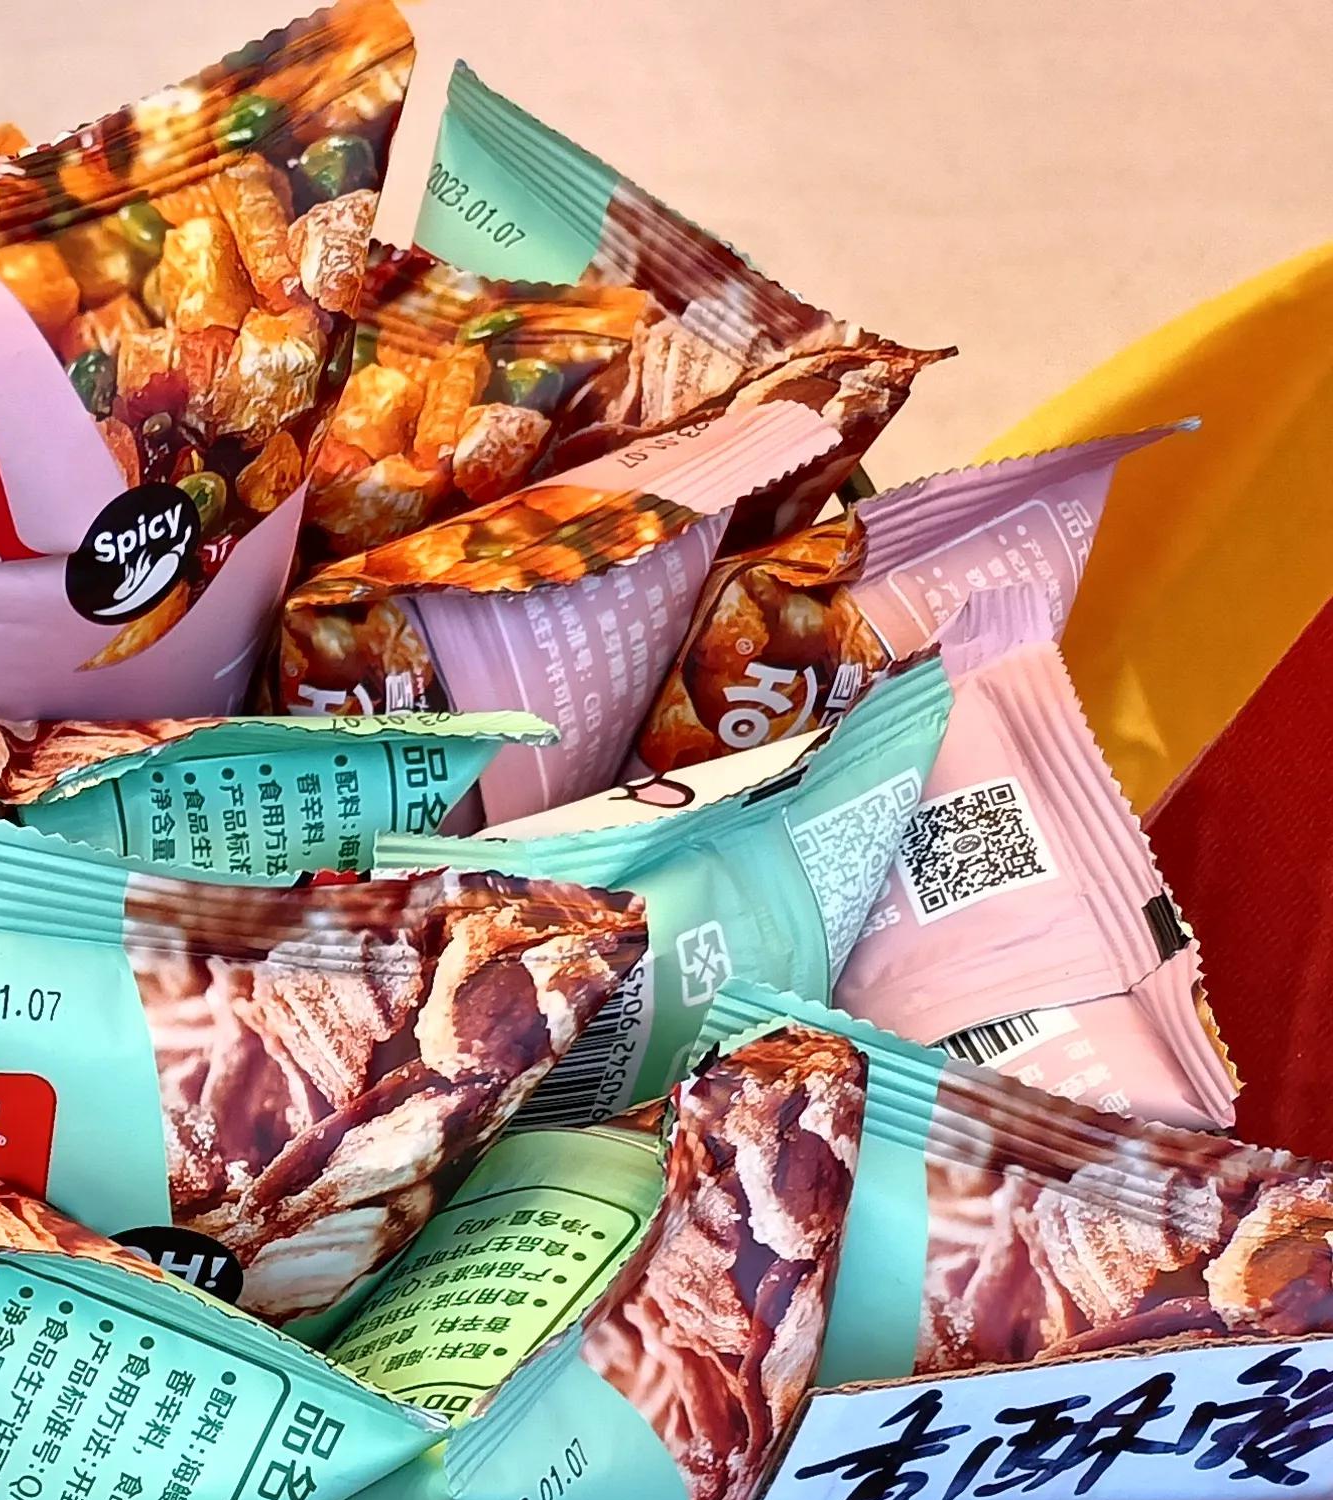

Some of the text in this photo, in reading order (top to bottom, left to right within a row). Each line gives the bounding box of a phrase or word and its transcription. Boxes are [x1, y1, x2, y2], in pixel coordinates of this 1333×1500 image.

[427, 163, 526, 248] 2023.01.07
[94, 502, 184, 566] Spicy
[149, 786, 177, 862] 净含量
[403, 744, 450, 834] 品名
